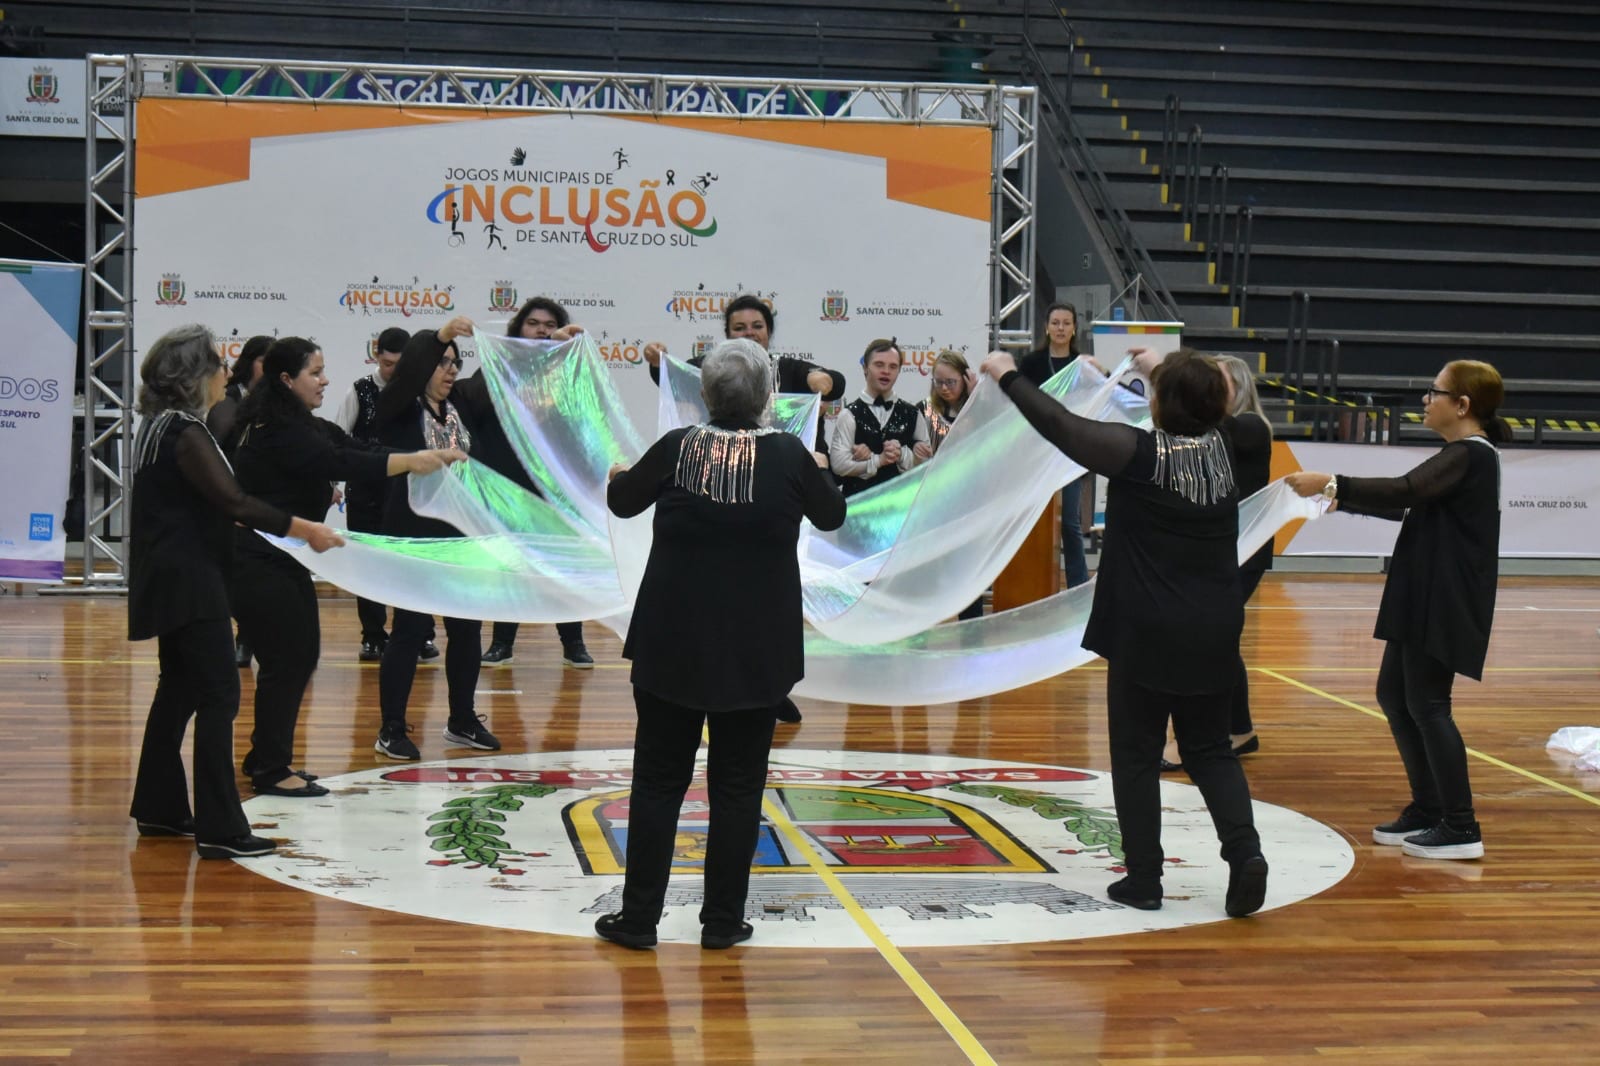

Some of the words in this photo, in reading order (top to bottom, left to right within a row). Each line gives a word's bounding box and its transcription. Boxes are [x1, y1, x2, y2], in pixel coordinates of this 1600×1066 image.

[445, 168, 499, 182] JOGOS
[503, 171, 590, 184] MUNICIPAIS
[594, 173, 614, 185] DE
[444, 179, 707, 230] INCLUSÃO
[516, 230, 537, 243] DE
[541, 231, 589, 244] SANTA
[597, 232, 639, 246] CRUZ
[642, 233, 666, 246] DO
[670, 234, 698, 247] SUL
[194, 291, 225, 299] SANTA
[227, 291, 251, 300] CRUZ
[253, 292, 268, 300] DO
[270, 292, 287, 300] SUL
[346, 287, 451, 308] INCLUSÃO
[558, 299, 581, 307] CRUZ
[600, 300, 616, 308] SUL
[856, 307, 885, 315] SANTA
[887, 308, 910, 316] CRUZ
[912, 308, 925, 316] DO
[799, 352, 814, 360] SUL
[0, 420, 17, 429] SUL
[1508, 500, 1535, 508] SANTA
[1559, 501, 1572, 509] DO
[1573, 501, 1588, 509] SUL
